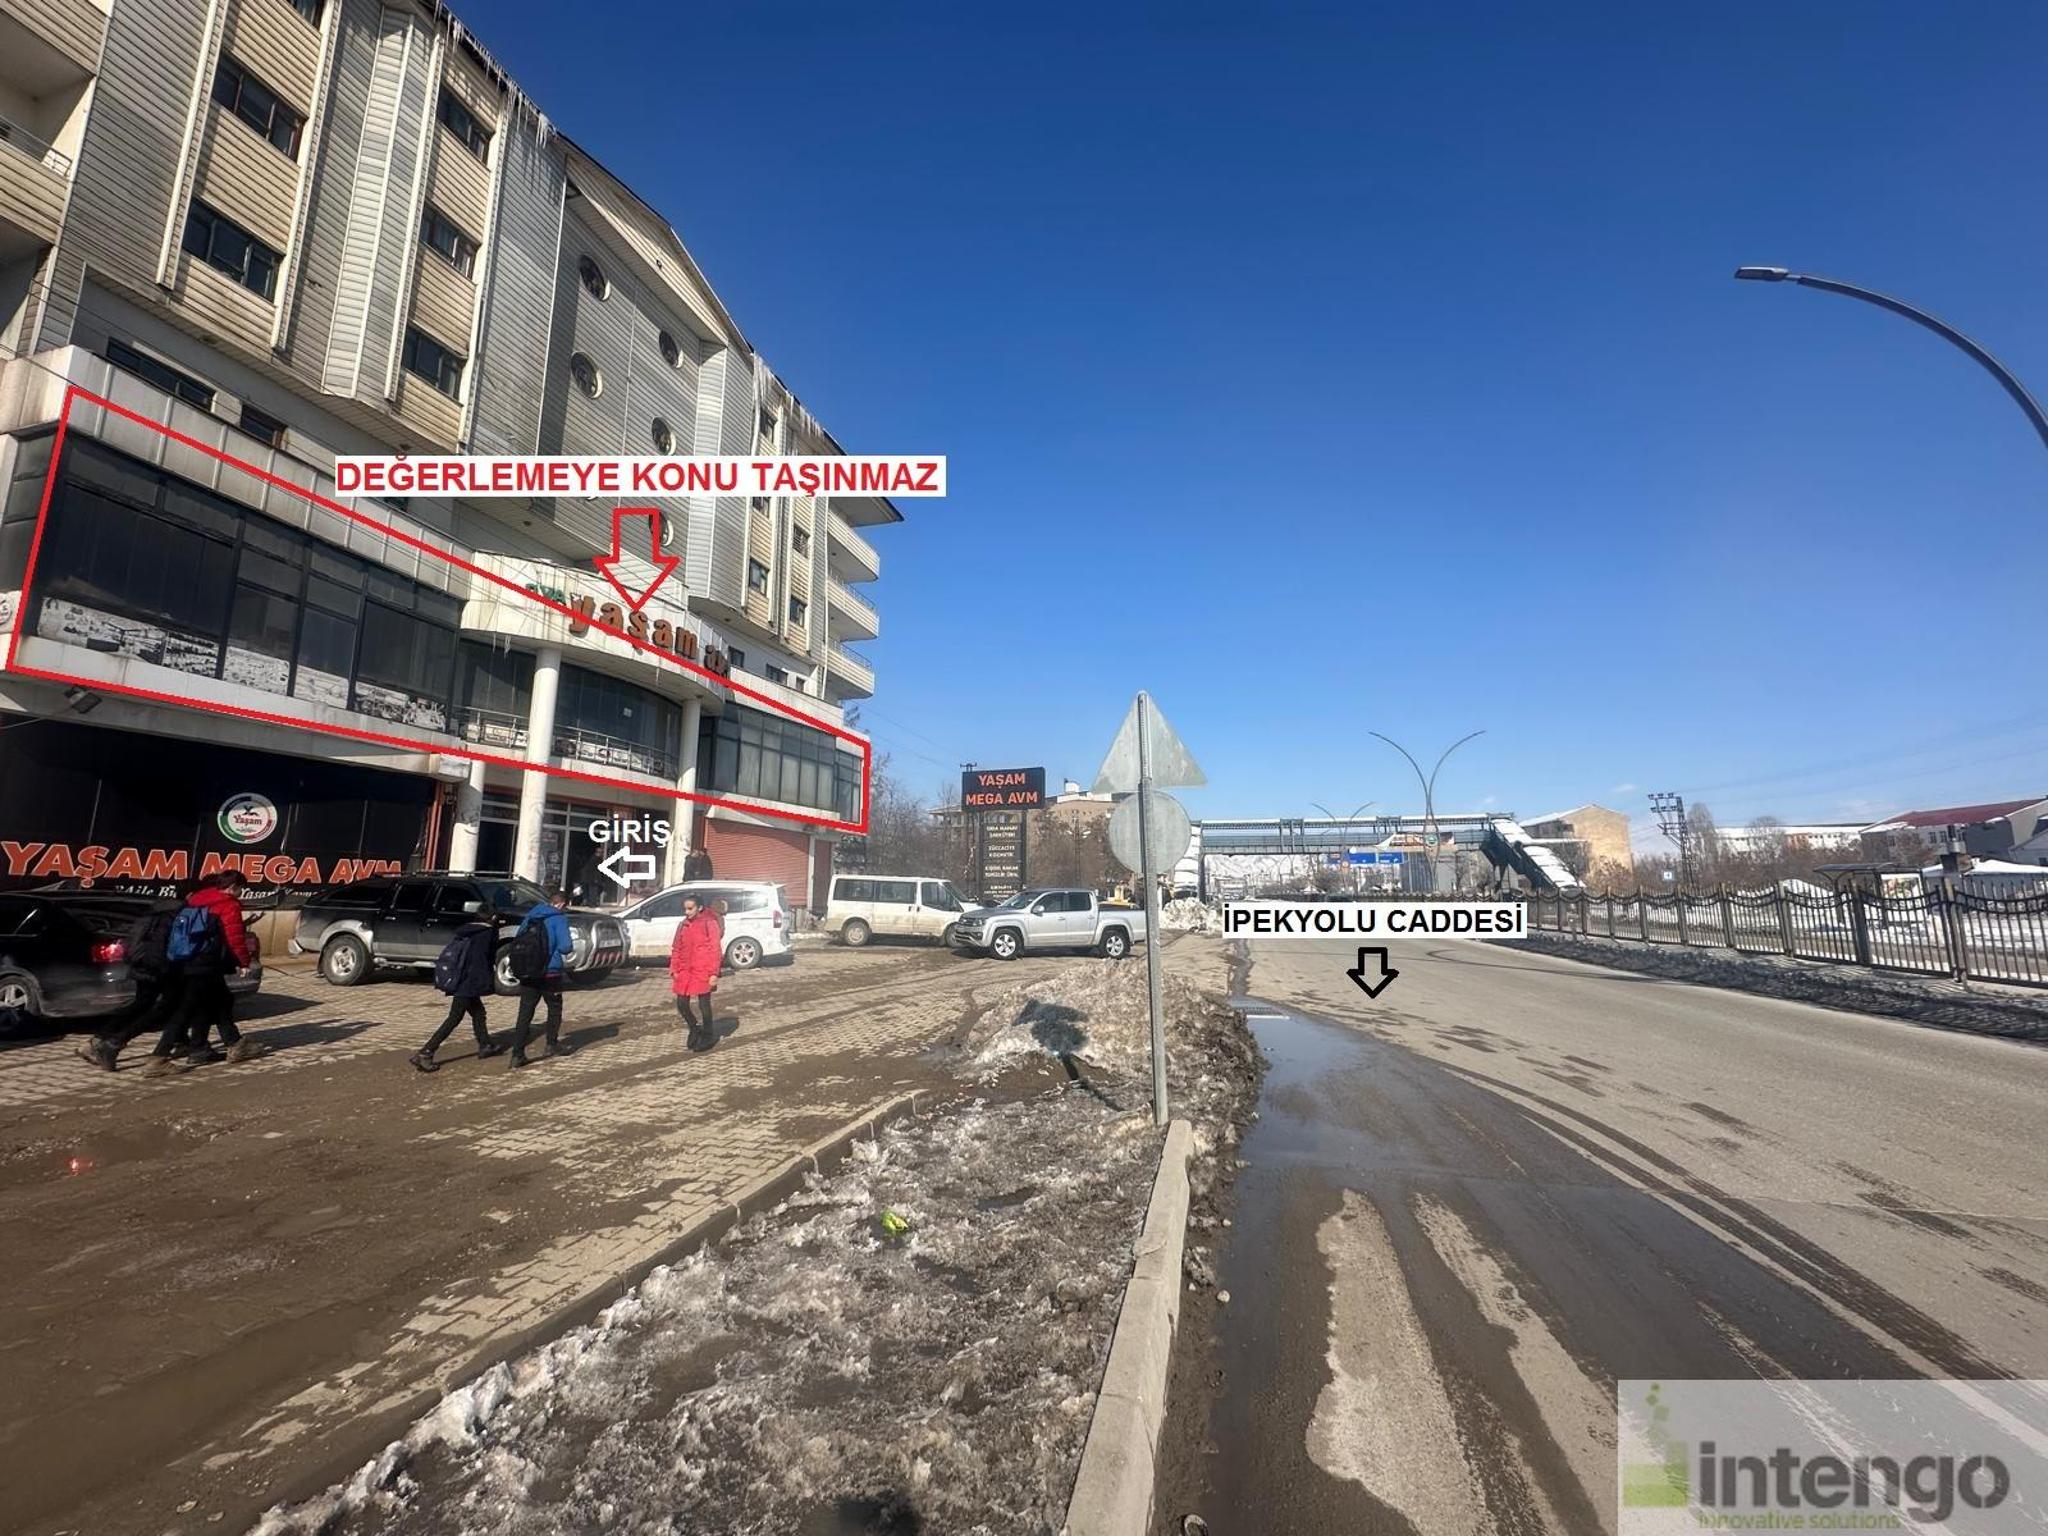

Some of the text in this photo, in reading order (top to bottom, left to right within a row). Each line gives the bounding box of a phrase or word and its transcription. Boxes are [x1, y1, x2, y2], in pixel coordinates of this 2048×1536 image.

[979, 773, 1026, 789] YAŞAM
[966, 791, 1038, 806] MEGA AVM
[1, 840, 402, 888] YAŞAM MEGA AVM
